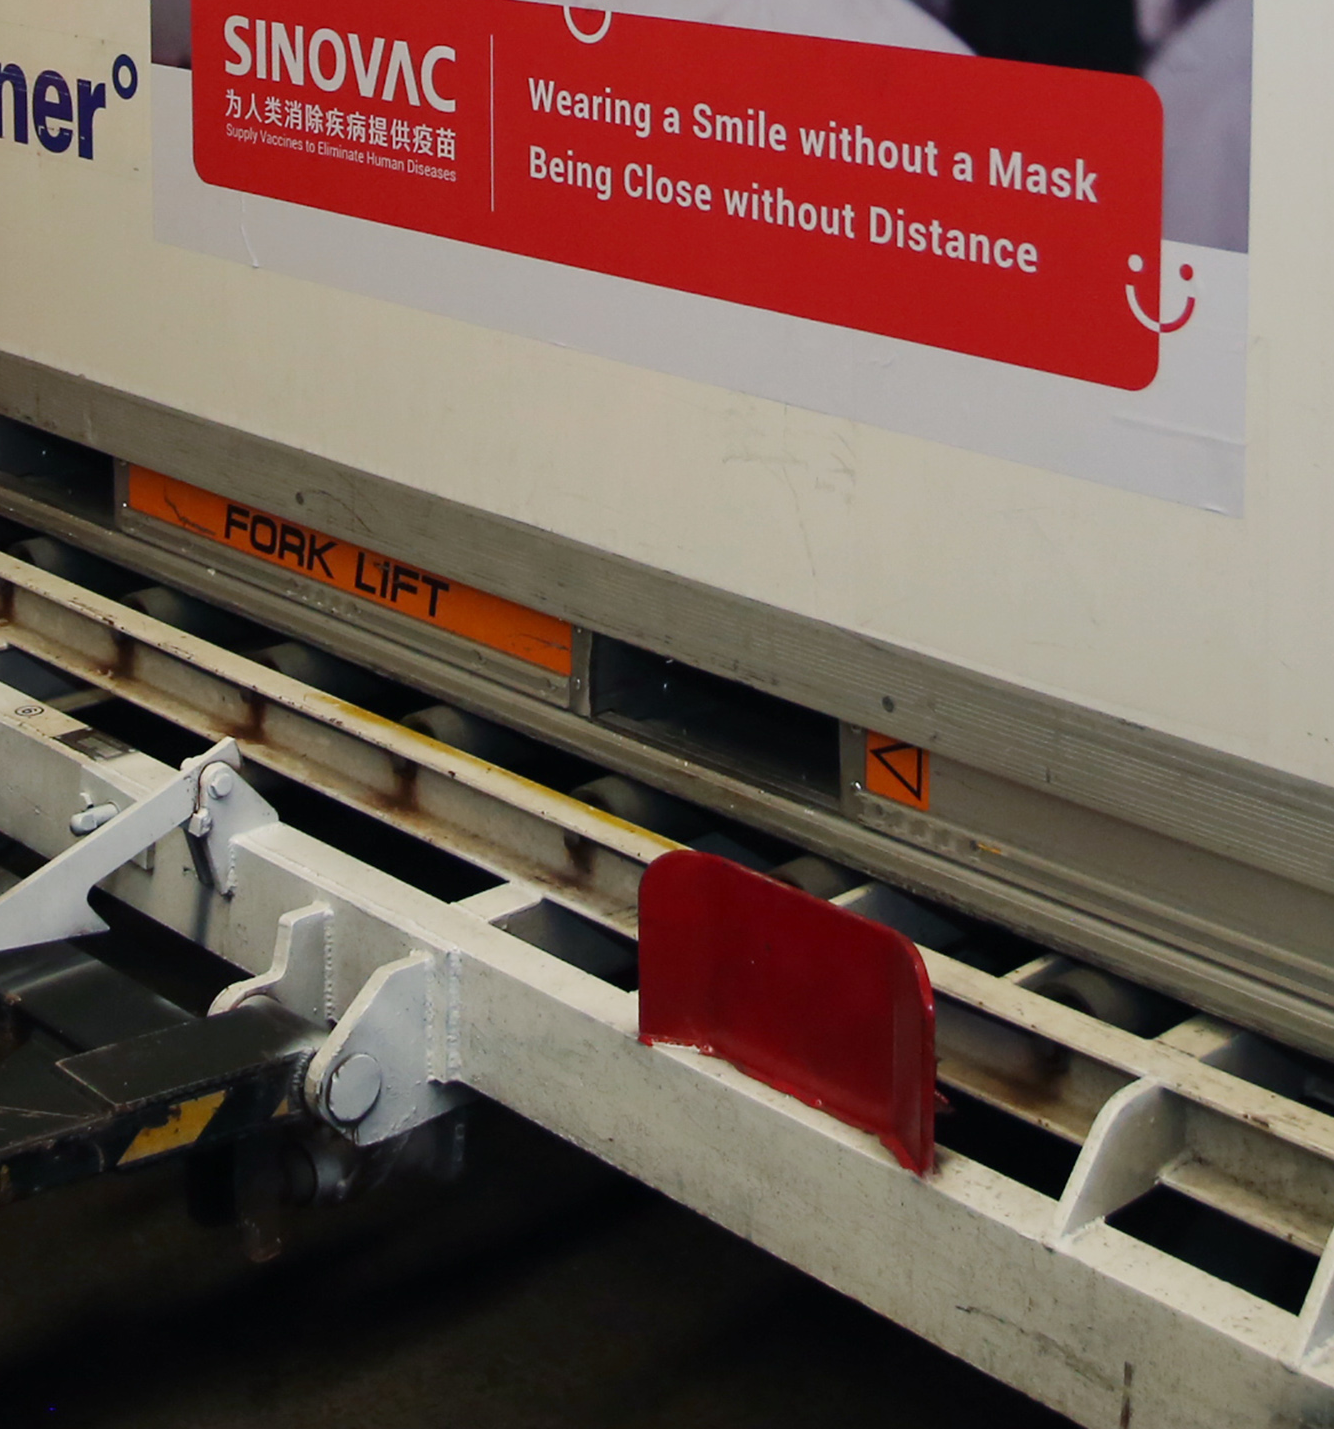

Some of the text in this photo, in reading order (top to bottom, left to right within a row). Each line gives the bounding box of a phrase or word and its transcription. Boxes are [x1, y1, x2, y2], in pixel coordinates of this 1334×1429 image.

[223, 14, 457, 113] SINOVAC
[225, 88, 457, 161] 为人类消除疾病提供疫苗
[226, 122, 457, 183] Supply Vaccines to Eliminate Human Diseases
[528, 76, 1098, 204] Wearing a Smile without a Mask
[529, 144, 1039, 274] Being Close without Distance
[224, 503, 450, 619] FORK LIFT
